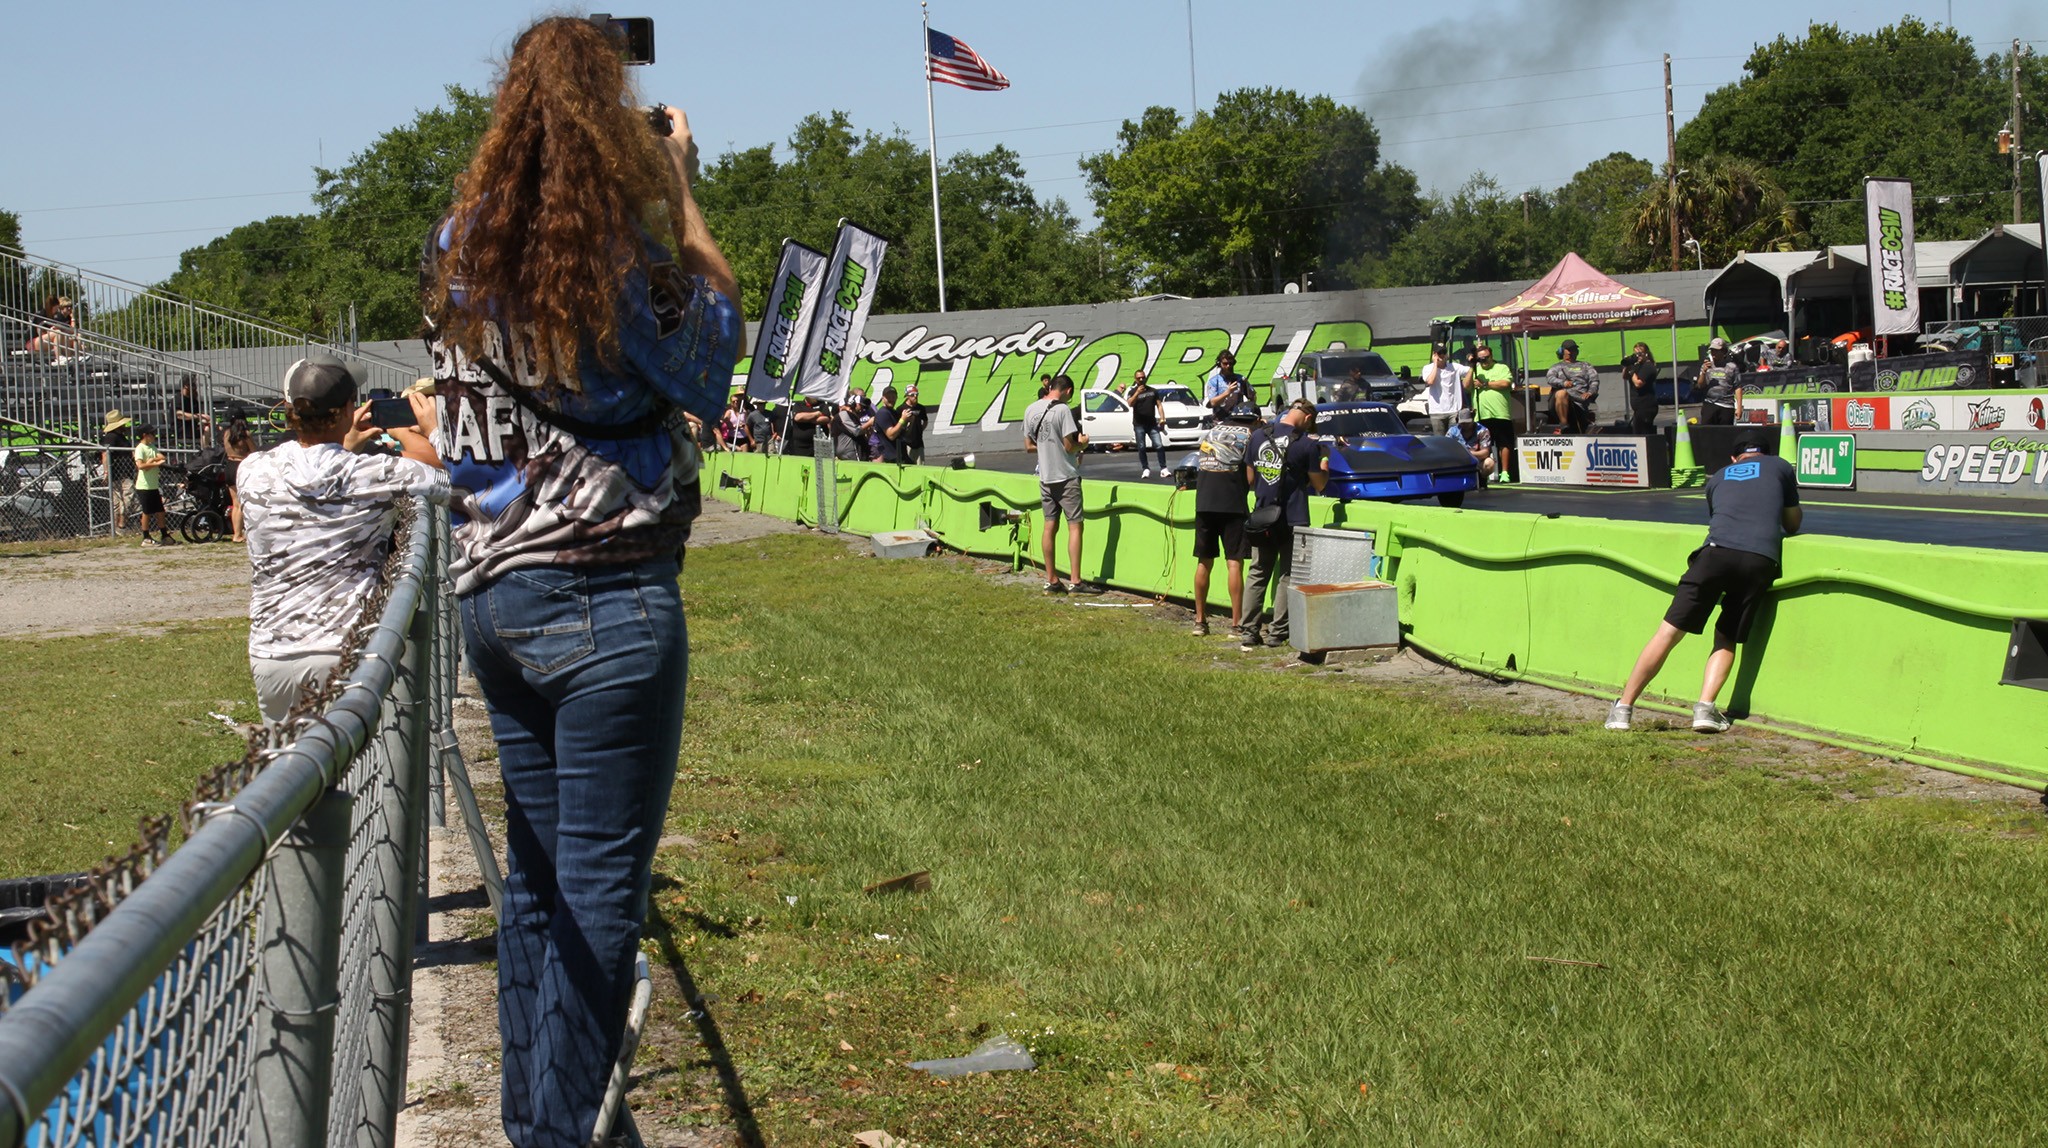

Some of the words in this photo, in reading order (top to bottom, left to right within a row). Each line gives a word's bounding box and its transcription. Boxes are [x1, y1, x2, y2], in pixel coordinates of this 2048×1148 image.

[1879, 206, 1908, 310] #RACEOSW
[763, 270, 807, 379] #RACEOSW
[819, 254, 867, 376] #RACEOSW
[856, 321, 1076, 364] rlando
[1523, 439, 1542, 447] MICKEY
[1543, 439, 1573, 447] THOMPSON
[1536, 449, 1562, 472] M/T
[1586, 439, 1638, 472] Strange
[1801, 447, 1837, 475] REAL
[1838, 440, 1849, 457] ST
[1922, 444, 2028, 484] SPEED
